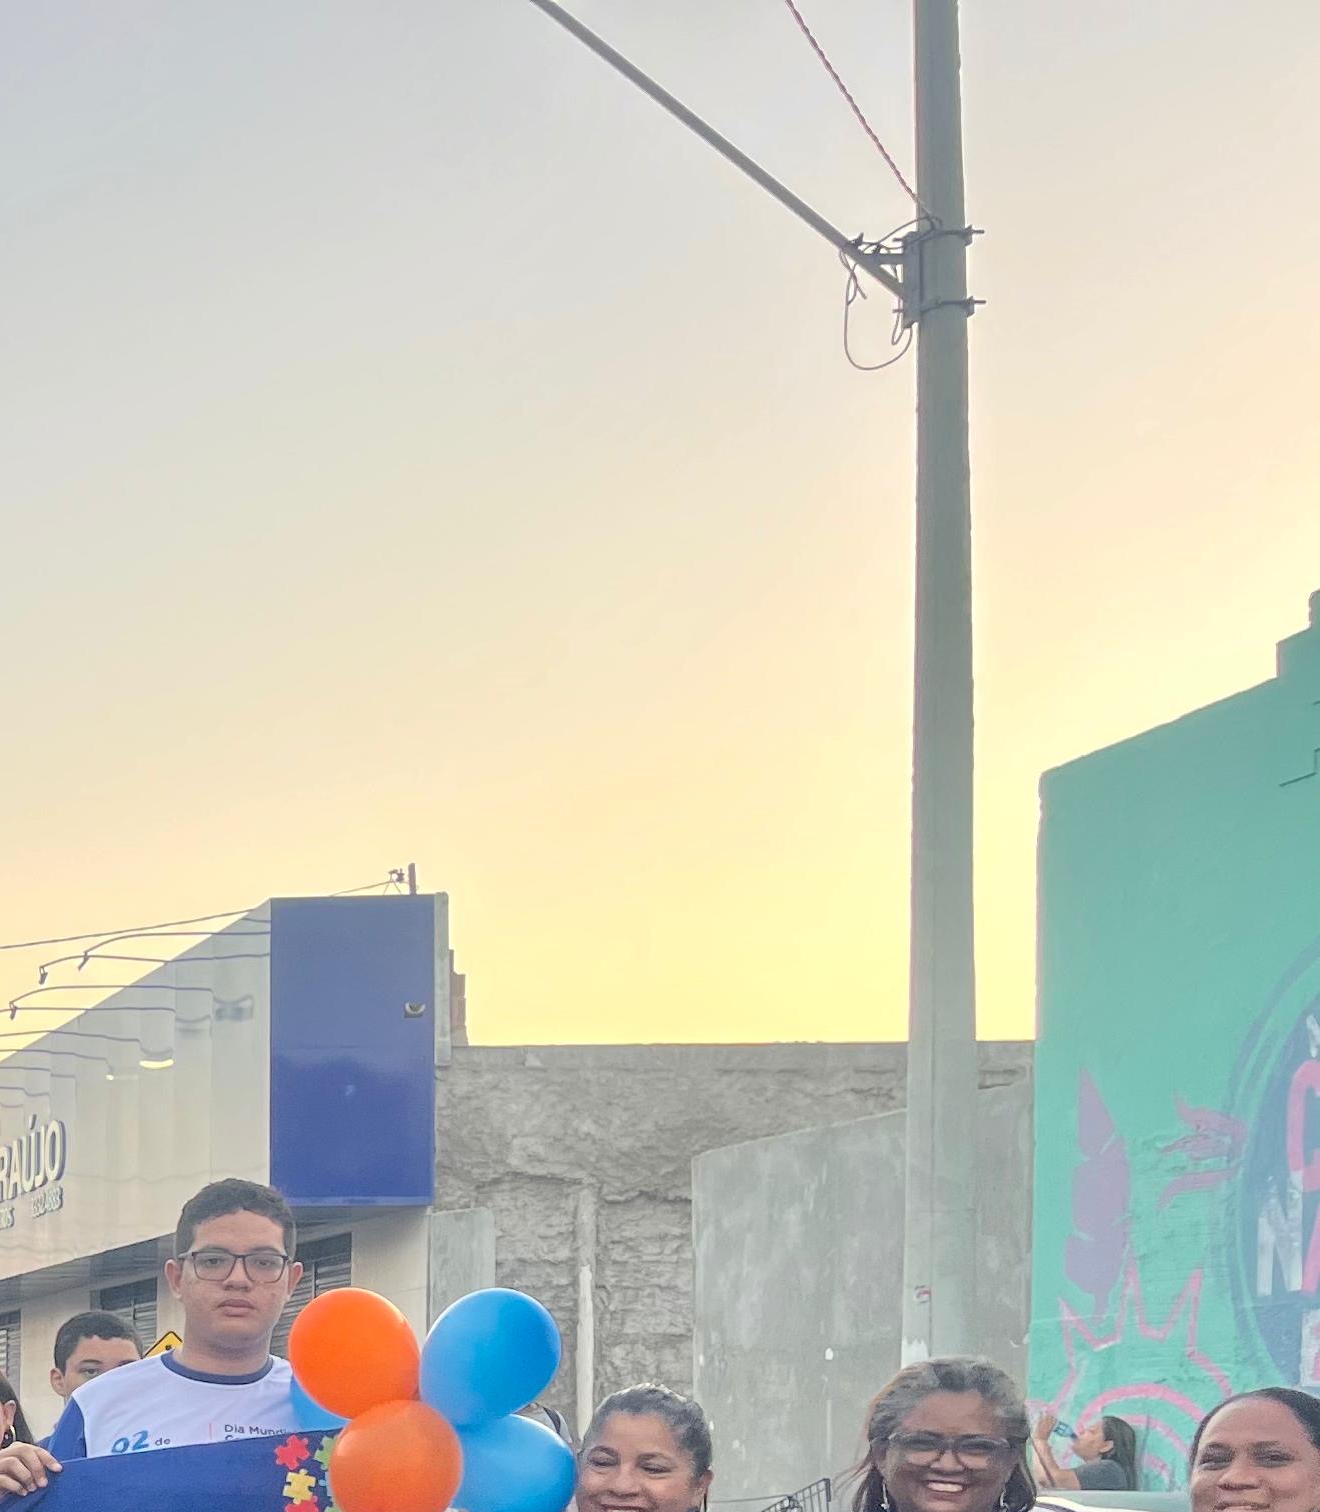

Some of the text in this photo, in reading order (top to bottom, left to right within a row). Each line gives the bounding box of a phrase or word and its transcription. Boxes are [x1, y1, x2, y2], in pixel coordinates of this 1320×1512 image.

[224, 1423, 245, 1434] Dia
[111, 1430, 171, 1453] 02 de
